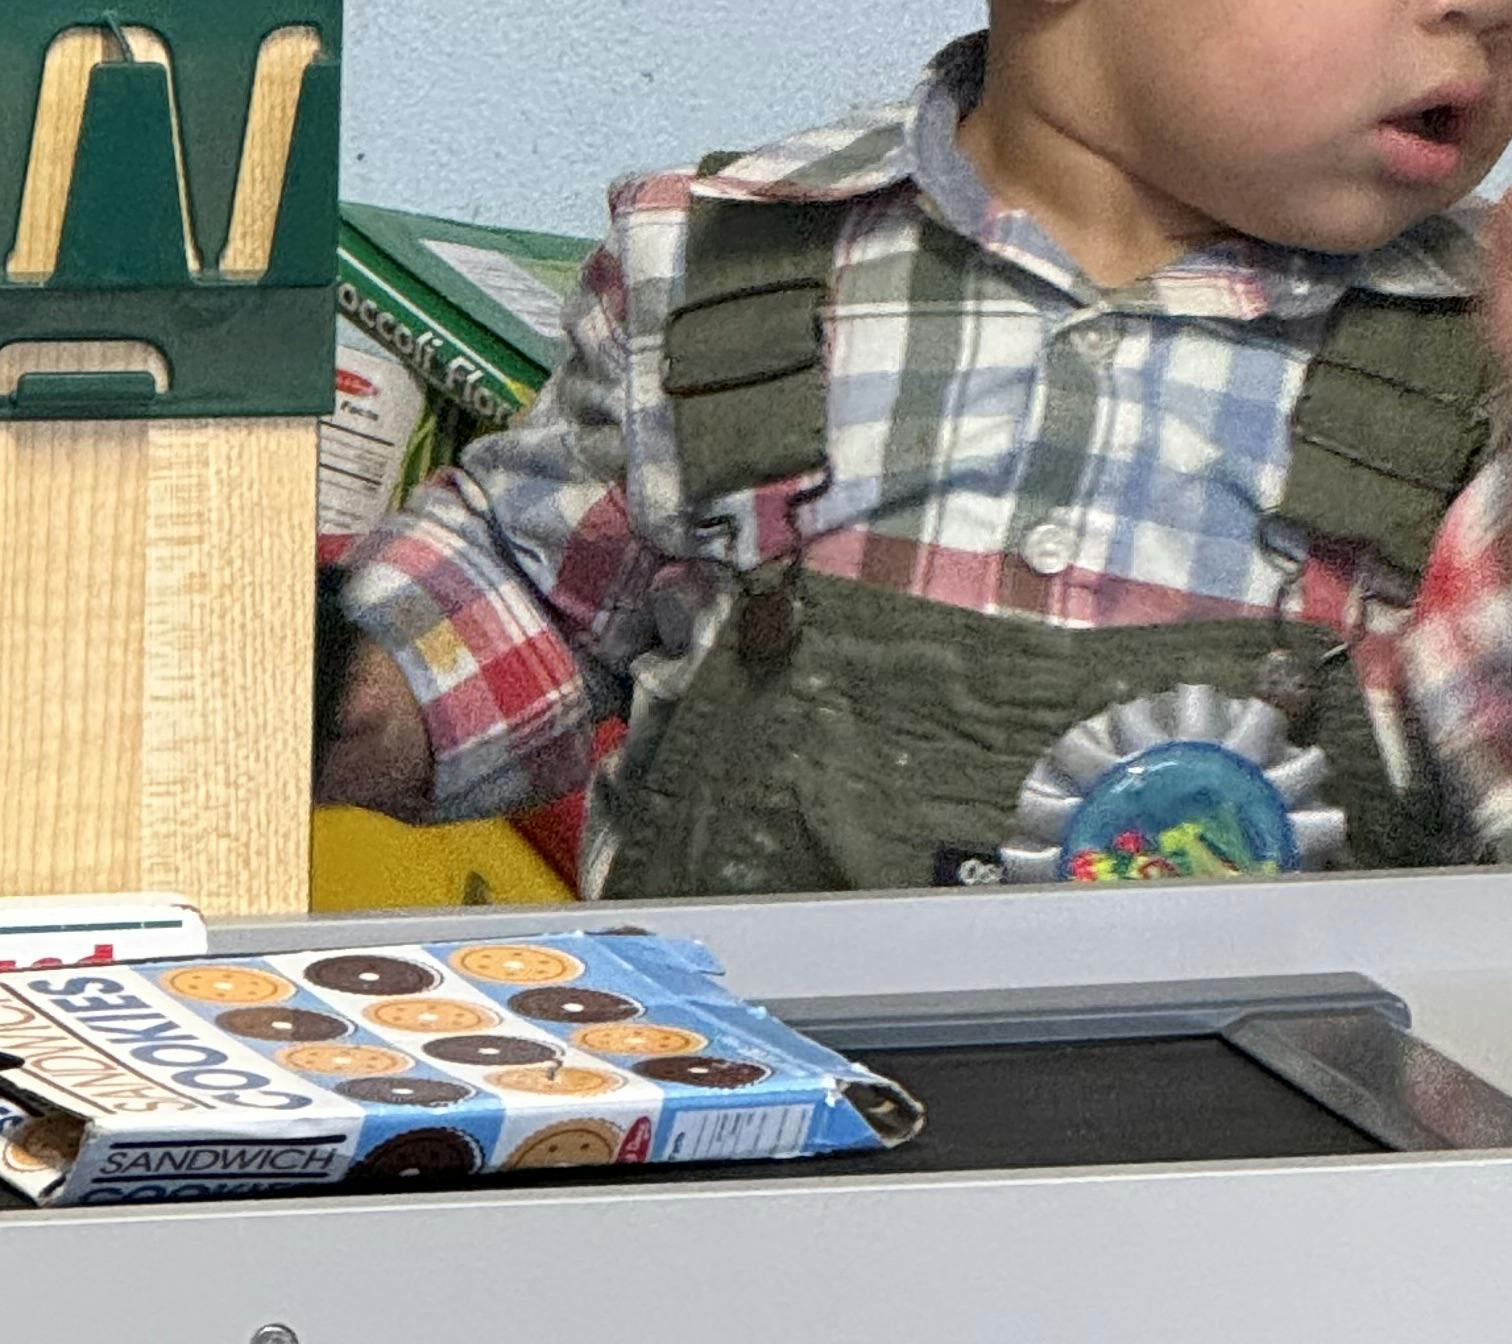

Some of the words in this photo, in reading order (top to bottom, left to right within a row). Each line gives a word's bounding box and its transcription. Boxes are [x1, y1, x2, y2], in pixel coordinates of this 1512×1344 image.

[0, 999, 193, 1112] SANDWI
[27, 976, 313, 1110] COOKIES
[98, 1146, 338, 1175] SANDWICH
